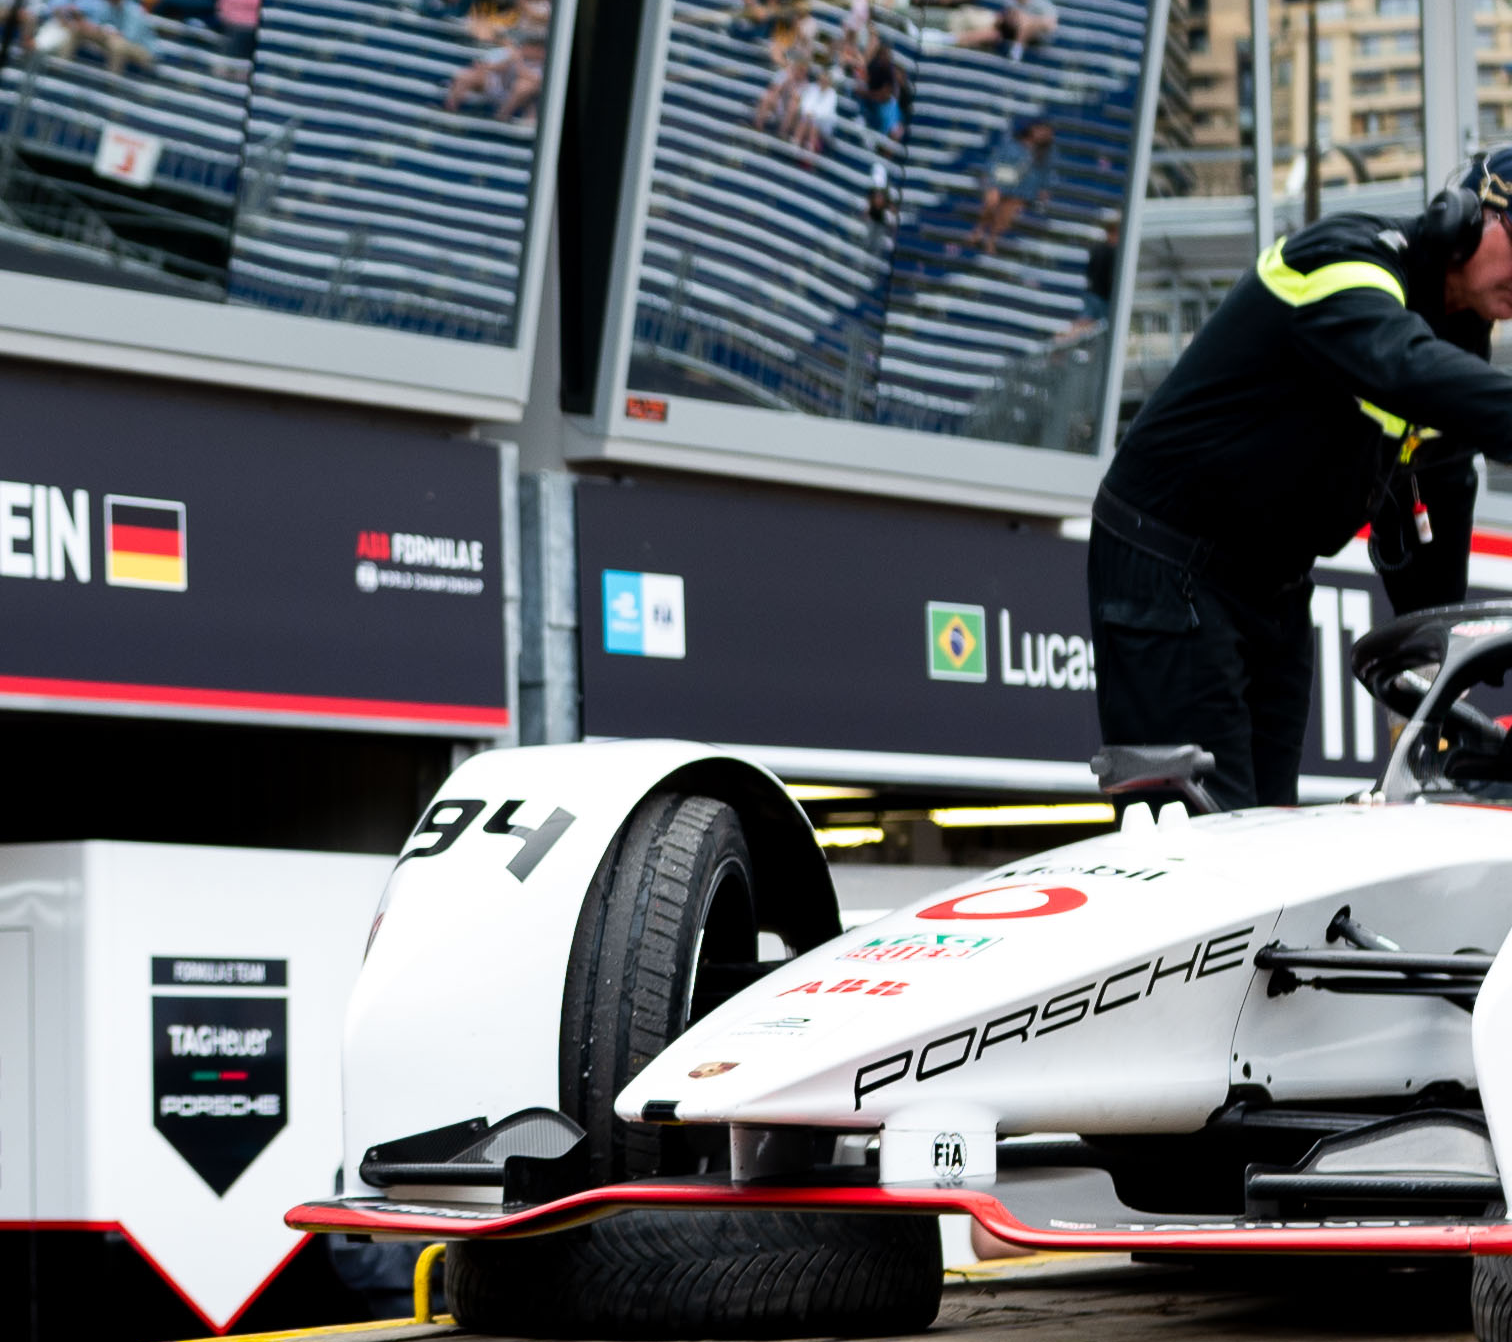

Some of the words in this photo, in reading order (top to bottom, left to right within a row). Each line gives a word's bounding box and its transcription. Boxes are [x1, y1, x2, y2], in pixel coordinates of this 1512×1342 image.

[392, 799, 577, 883] 94
[776, 978, 910, 997] ABB
[854, 926, 1255, 1113] PORSCHE
[160, 1093, 281, 1117] PORSCHE
